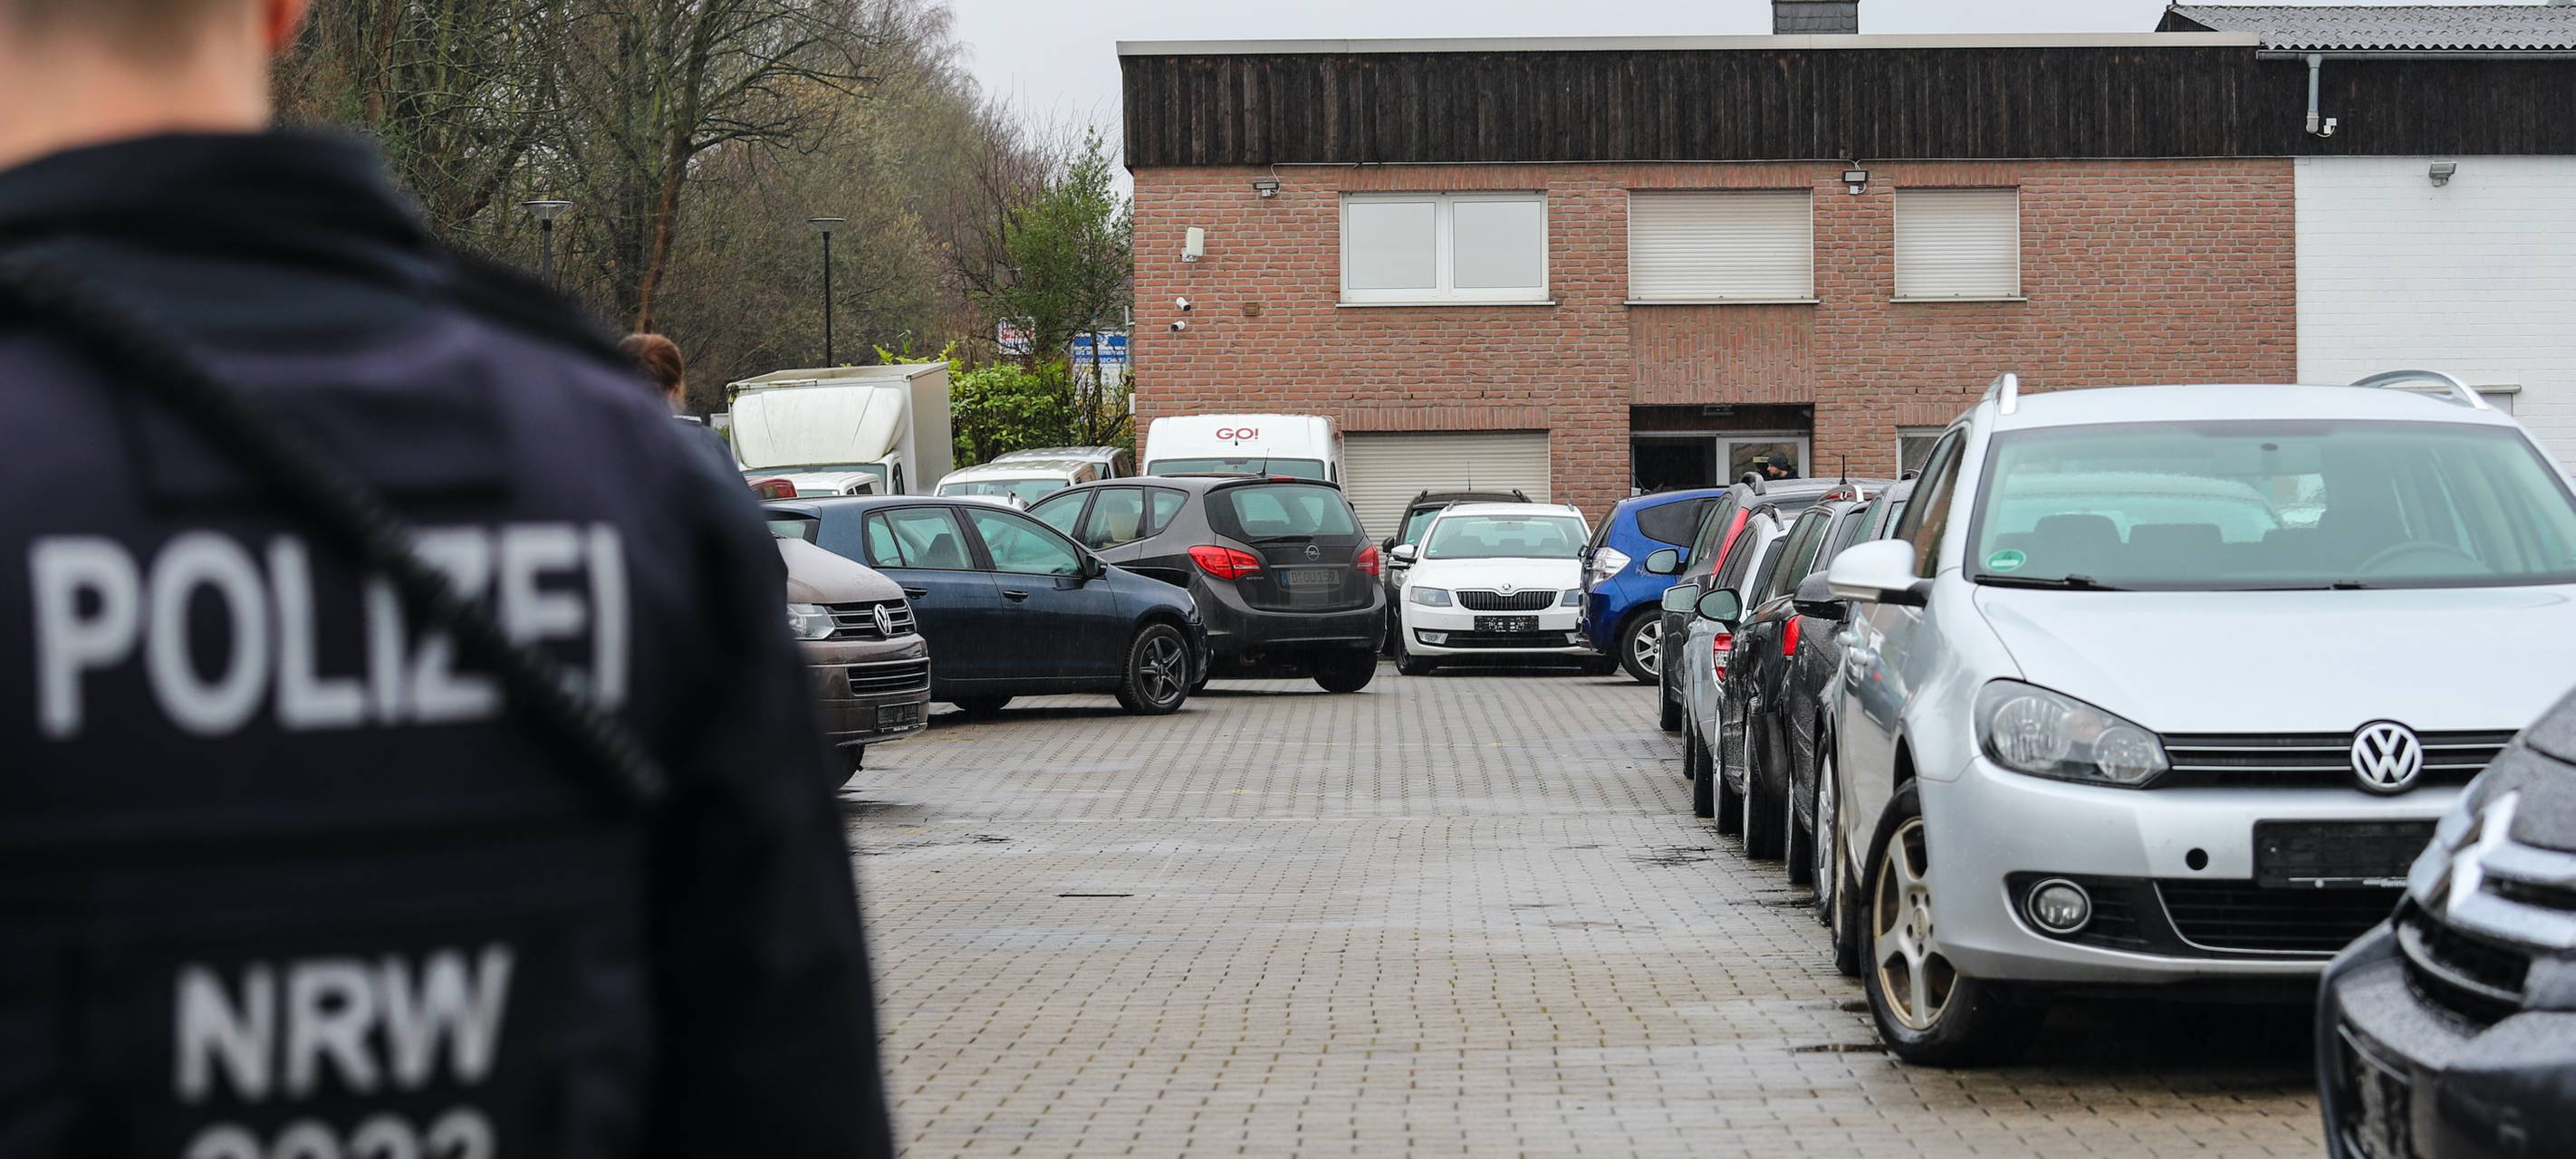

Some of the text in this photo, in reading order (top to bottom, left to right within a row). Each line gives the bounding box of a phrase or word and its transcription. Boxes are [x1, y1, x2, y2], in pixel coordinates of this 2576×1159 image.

[1216, 427, 1258, 439] GO!
[29, 523, 632, 737] POLIZEI
[174, 942, 514, 1104] NRW
